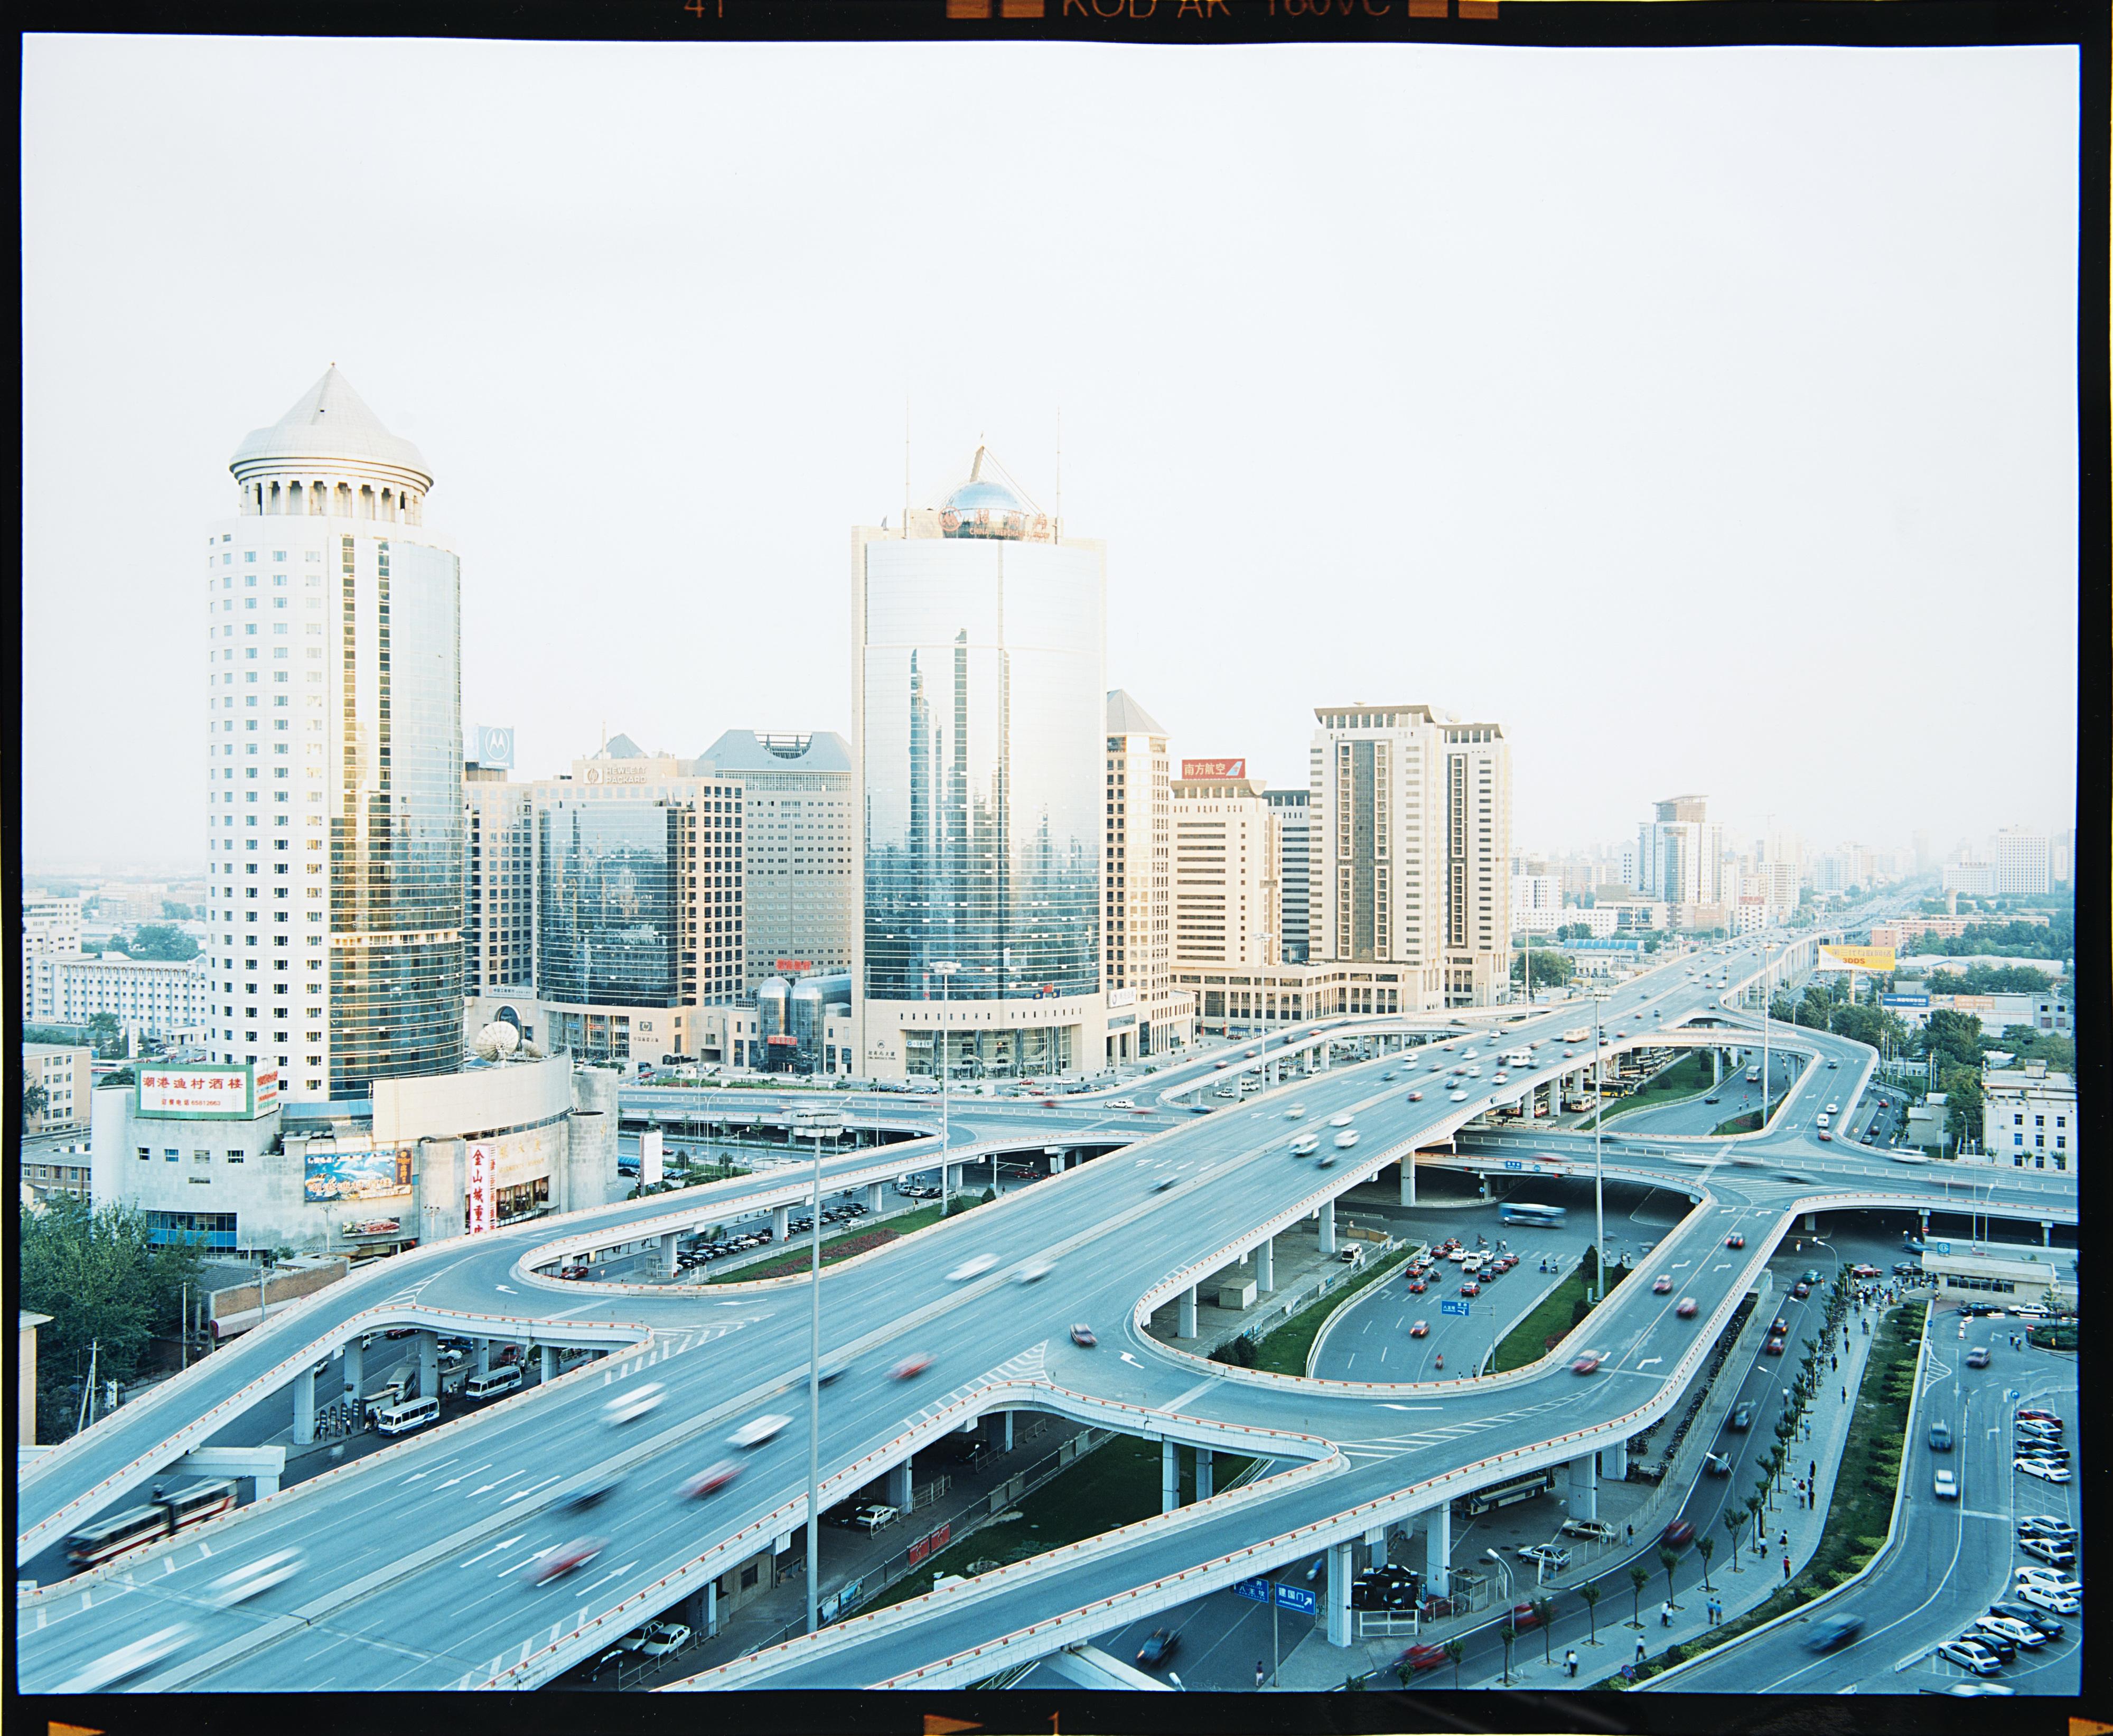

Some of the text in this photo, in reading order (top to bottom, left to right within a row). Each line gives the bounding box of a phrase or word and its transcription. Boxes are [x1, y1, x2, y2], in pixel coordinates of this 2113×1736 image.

[1184, 763, 1226, 776] 南方航空
[143, 1076, 243, 1089] 潮港渔村酒楼
[1239, 1586, 1265, 1597] 八王坟
[1278, 1587, 1304, 1602] 建国门
